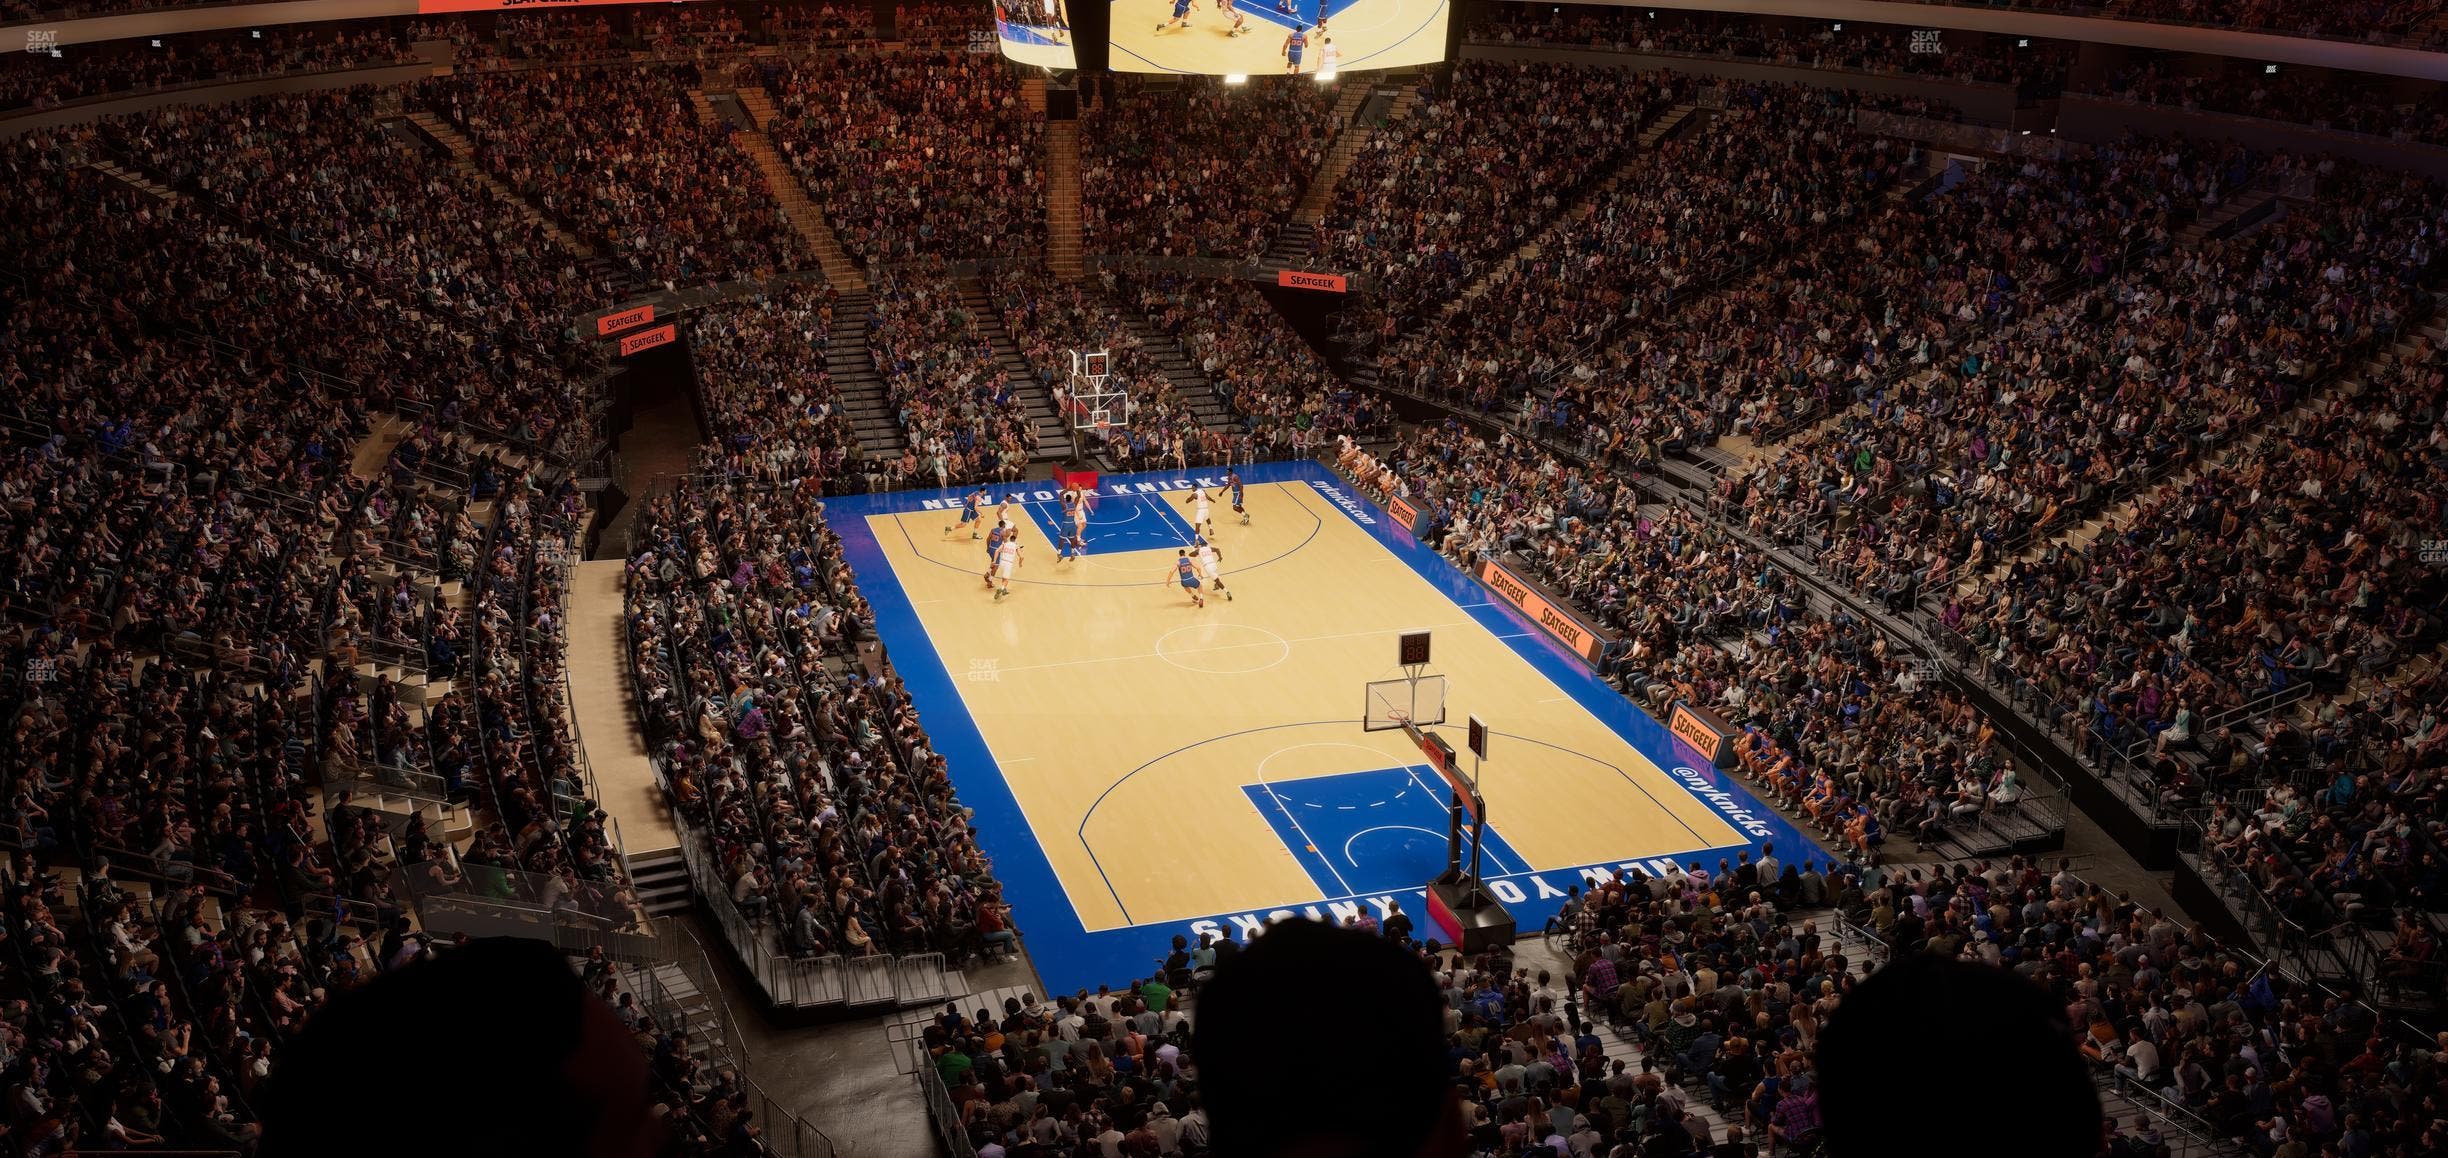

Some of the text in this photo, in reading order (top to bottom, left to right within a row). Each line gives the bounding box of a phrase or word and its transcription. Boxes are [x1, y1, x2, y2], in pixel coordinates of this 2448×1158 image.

[1290, 275, 1335, 289] SEATGEEK
[607, 312, 644, 331] SEATGEEK
[629, 331, 666, 351] SEATGEEK
[1390, 500, 1416, 527] SEATGEEK
[1490, 570, 1581, 648] SEATGEEK SEATGEEK
[1674, 714, 1717, 757] SEATGEEK
[1672, 766, 1774, 837] @nyknicks
